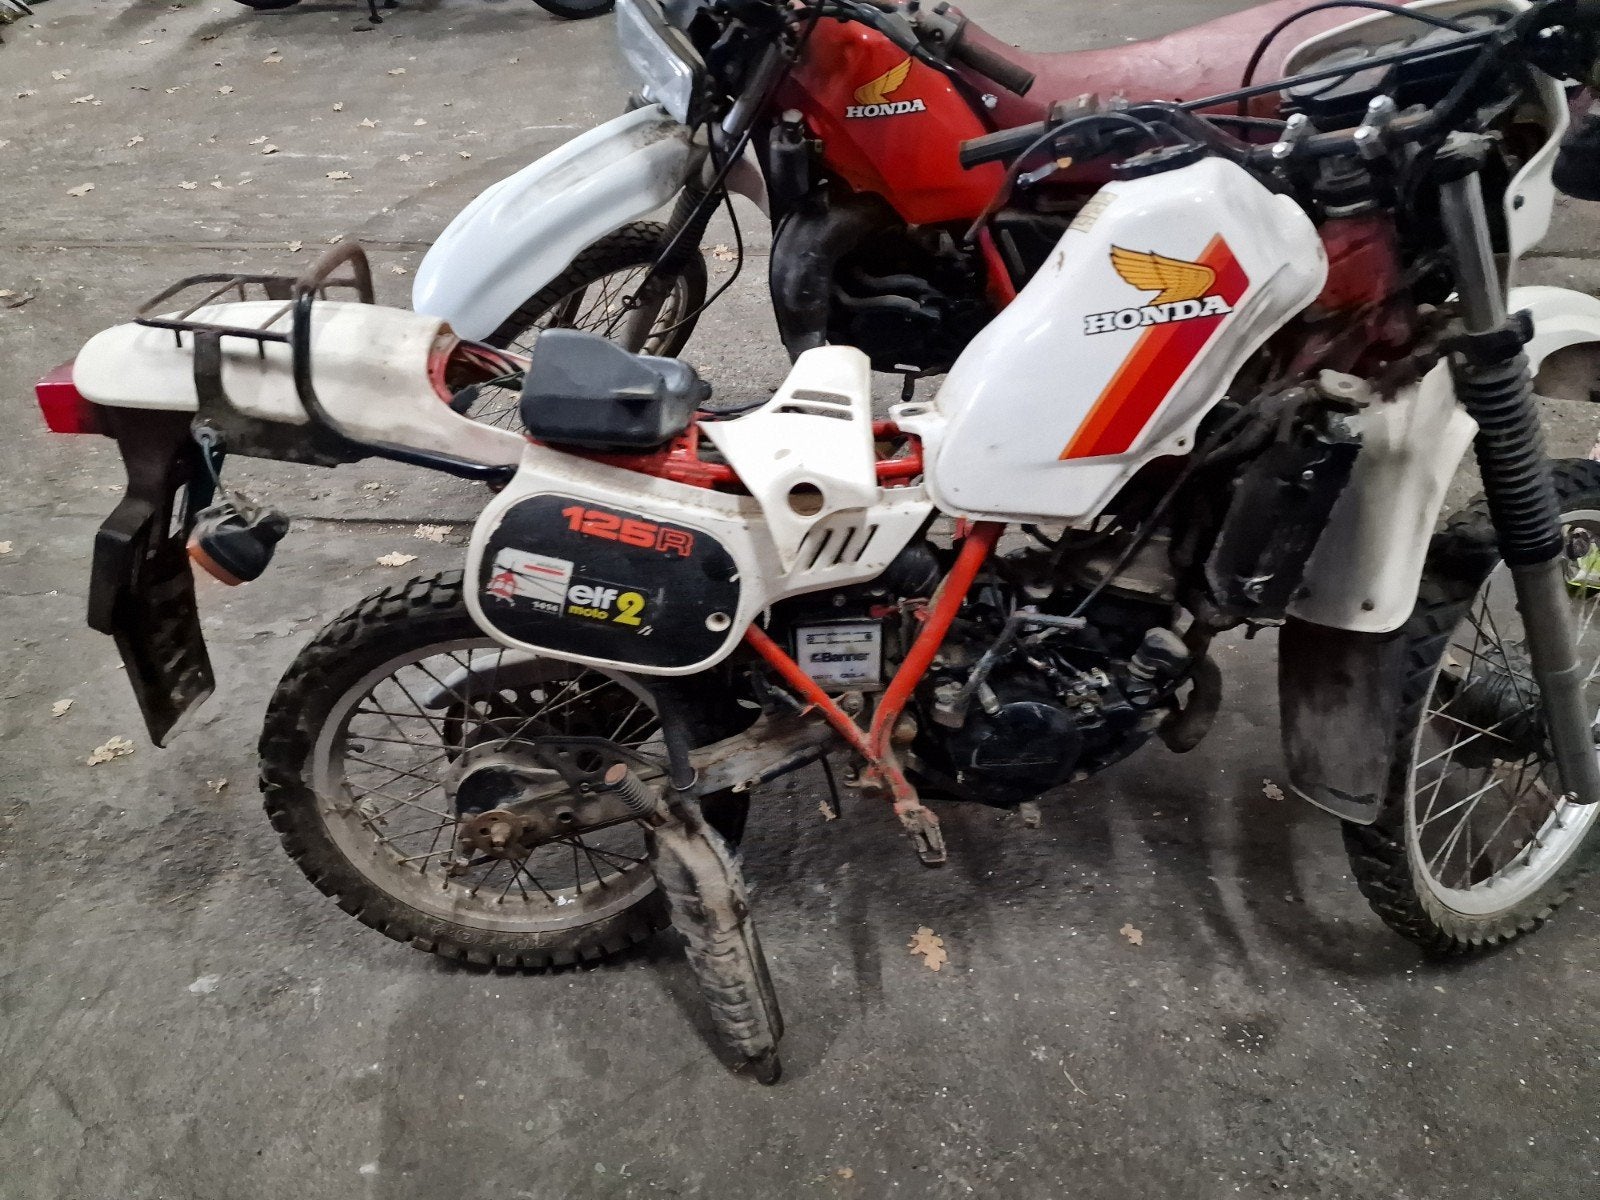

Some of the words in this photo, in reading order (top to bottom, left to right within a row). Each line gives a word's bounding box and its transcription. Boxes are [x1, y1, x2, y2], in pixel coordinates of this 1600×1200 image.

[845, 98, 926, 118] HONDA
[1084, 295, 1233, 335] HONDA
[562, 506, 694, 557] 125R
[567, 584, 618, 610] elf
[612, 591, 646, 626] 2
[567, 605, 609, 620] moto
